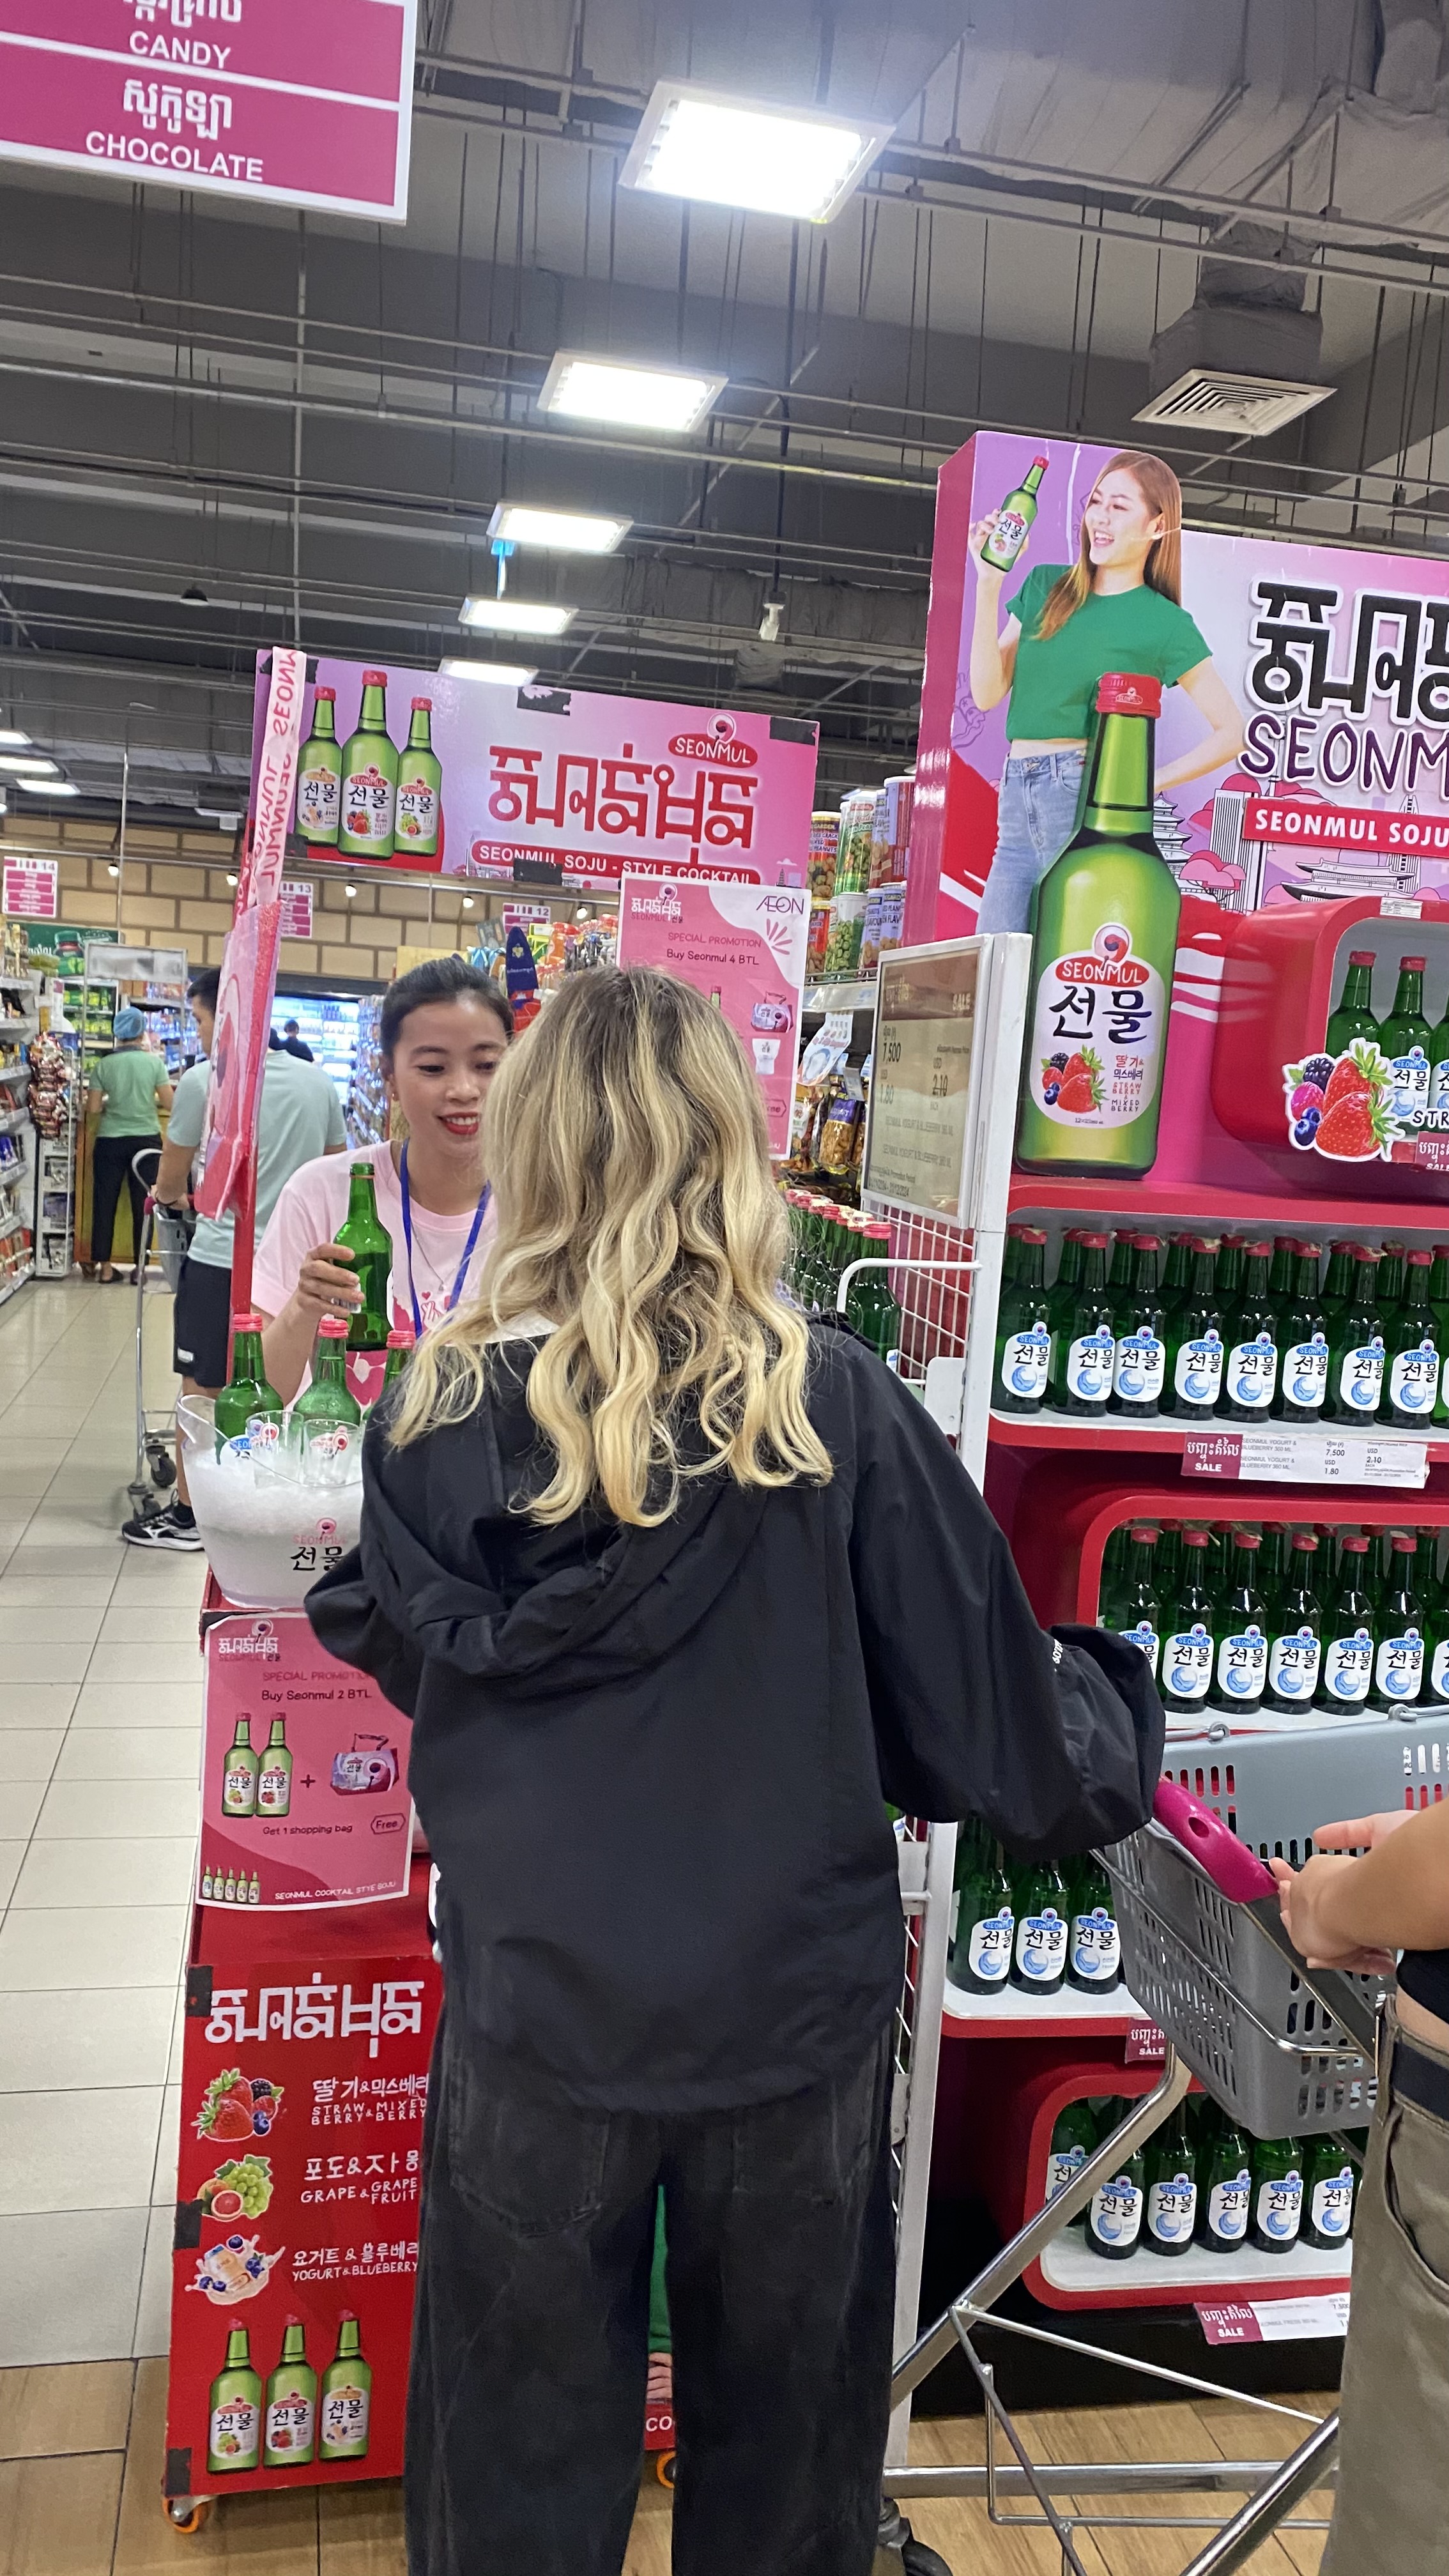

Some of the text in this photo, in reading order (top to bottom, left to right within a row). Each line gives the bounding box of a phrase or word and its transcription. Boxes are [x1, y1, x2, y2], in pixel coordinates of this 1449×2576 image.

[129, 31, 231, 70] CANDY
[86, 131, 264, 182] CHOCOLATE
[674, 737, 752, 765] SEONMUL
[1255, 808, 1449, 847] SEONMUL SOJU
[564, 854, 607, 872] SOJU
[298, 884, 311, 893] 13
[536, 907, 549, 916] 12
[631, 912, 666, 922] SEONMUL
[668, 933, 762, 948] SPECIAL PROMOTION
[667, 949, 760, 965] Buy Seonmul 4 BTL
[1062, 961, 1142, 983] SEONMUL
[952, 992, 971, 1011] SALE
[1395, 1059, 1427, 1070] SEONMUL
[1195, 1463, 1222, 1472] SALE
[1367, 1455, 1382, 1464] 2.10
[263, 1671, 307, 1682] SPECIAL
[261, 1689, 372, 1703] Buy Seonmul 2 BTL
[263, 1827, 280, 1836] Get
[289, 1825, 332, 1836] shopping
[335, 1825, 353, 1833] bag
[376, 1820, 398, 1829] Free
[275, 1890, 313, 1900] SEONMUL
[312, 2098, 427, 2116] STRAW MIXED
[311, 2108, 425, 2126] BERRY & BERRY
[371, 2177, 418, 2192] GRAPE
[300, 2186, 417, 2205] GRAPE & FRUIT
[292, 2247, 340, 2266] 요거트
[344, 2248, 357, 2261] &
[1217, 2327, 1245, 2338] SALE
